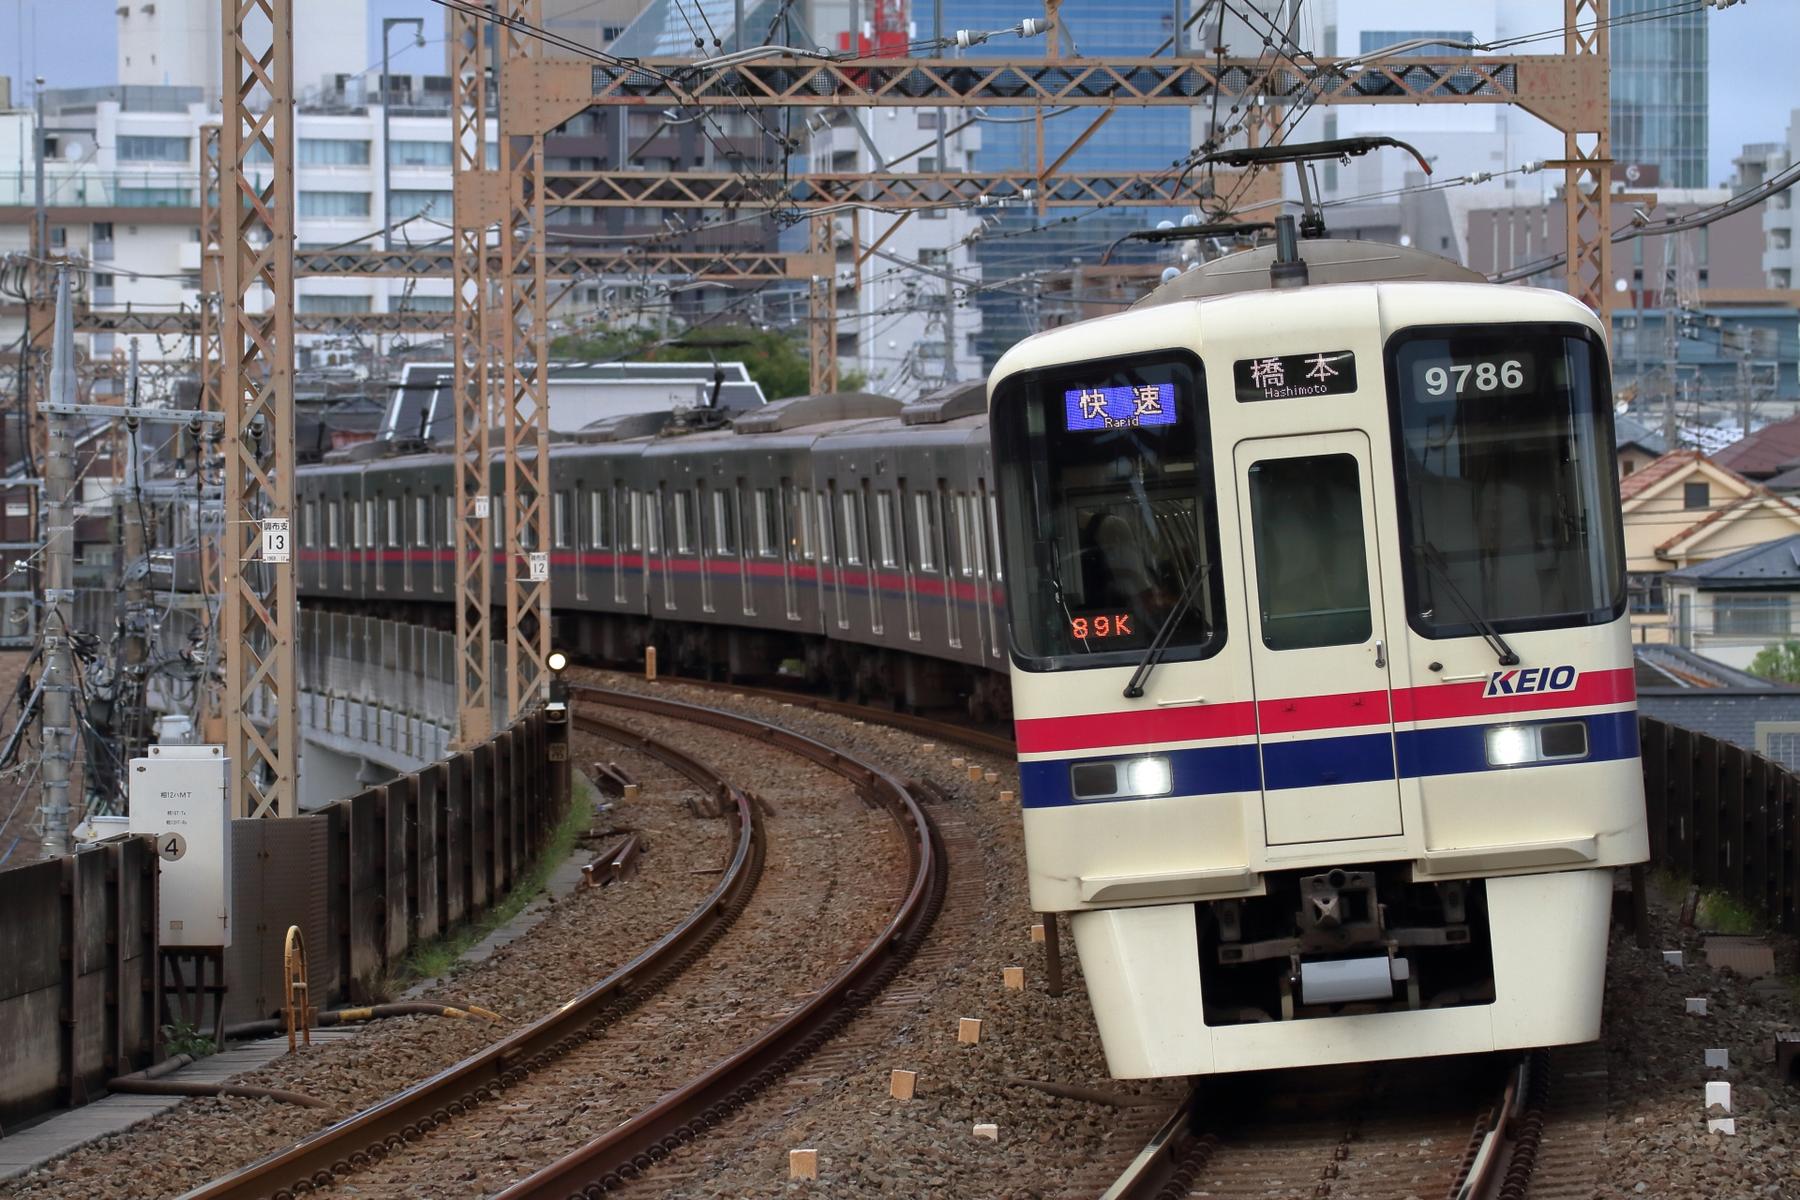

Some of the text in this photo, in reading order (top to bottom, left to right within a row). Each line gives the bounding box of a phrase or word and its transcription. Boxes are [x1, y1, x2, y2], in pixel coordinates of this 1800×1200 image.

[1250, 354, 1339, 389] 橋本
[1425, 360, 1524, 396] 9786
[1079, 384, 1163, 419] 快速
[1264, 384, 1328, 399] Hashimoto
[1104, 415, 1139, 428] Rapid
[269, 534, 284, 550] 13
[533, 562, 546, 573] 12
[1072, 614, 1132, 639] 89K
[1487, 665, 1576, 696] KEIO
[165, 838, 179, 856] 4
